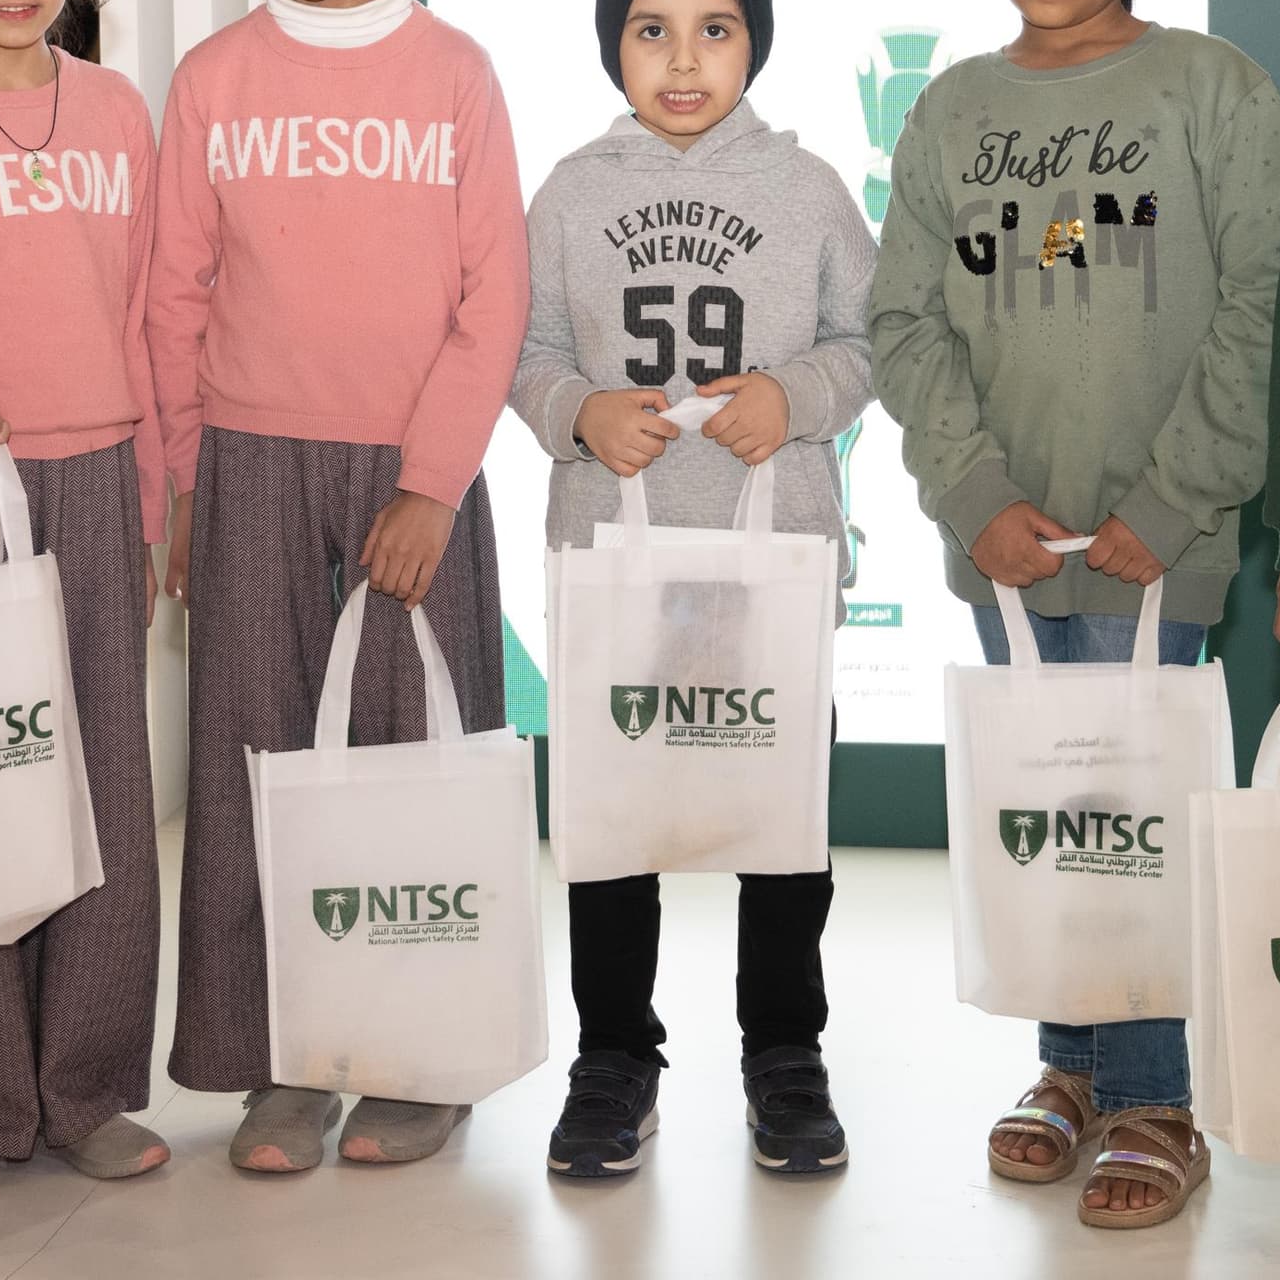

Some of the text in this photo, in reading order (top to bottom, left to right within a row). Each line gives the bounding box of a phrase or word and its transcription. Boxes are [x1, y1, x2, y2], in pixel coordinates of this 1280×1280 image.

[208, 115, 457, 186] AWESOME
[962, 120, 1149, 187] Just be
[604, 199, 764, 254] LEXINGTON
[626, 235, 735, 275] AVENUE
[623, 285, 744, 387] 59
[665, 685, 776, 727] NTSC
[665, 728, 776, 740] المركز الوطني لسلامة النقل
[665, 739, 775, 749] National Transport Safety Center
[13, 757, 33, 769] Safety
[34, 753, 55, 763] Center
[1055, 810, 1164, 854] NTSC
[1055, 853, 1164, 870] المركز الوطني لسلامة النقل
[1055, 864, 1163, 878] National Transport Safety Center
[368, 884, 478, 922] NTSC
[368, 924, 479, 938] المركز الوطني لسلامة النقل
[368, 934, 479, 945] National Transport Safety Center
